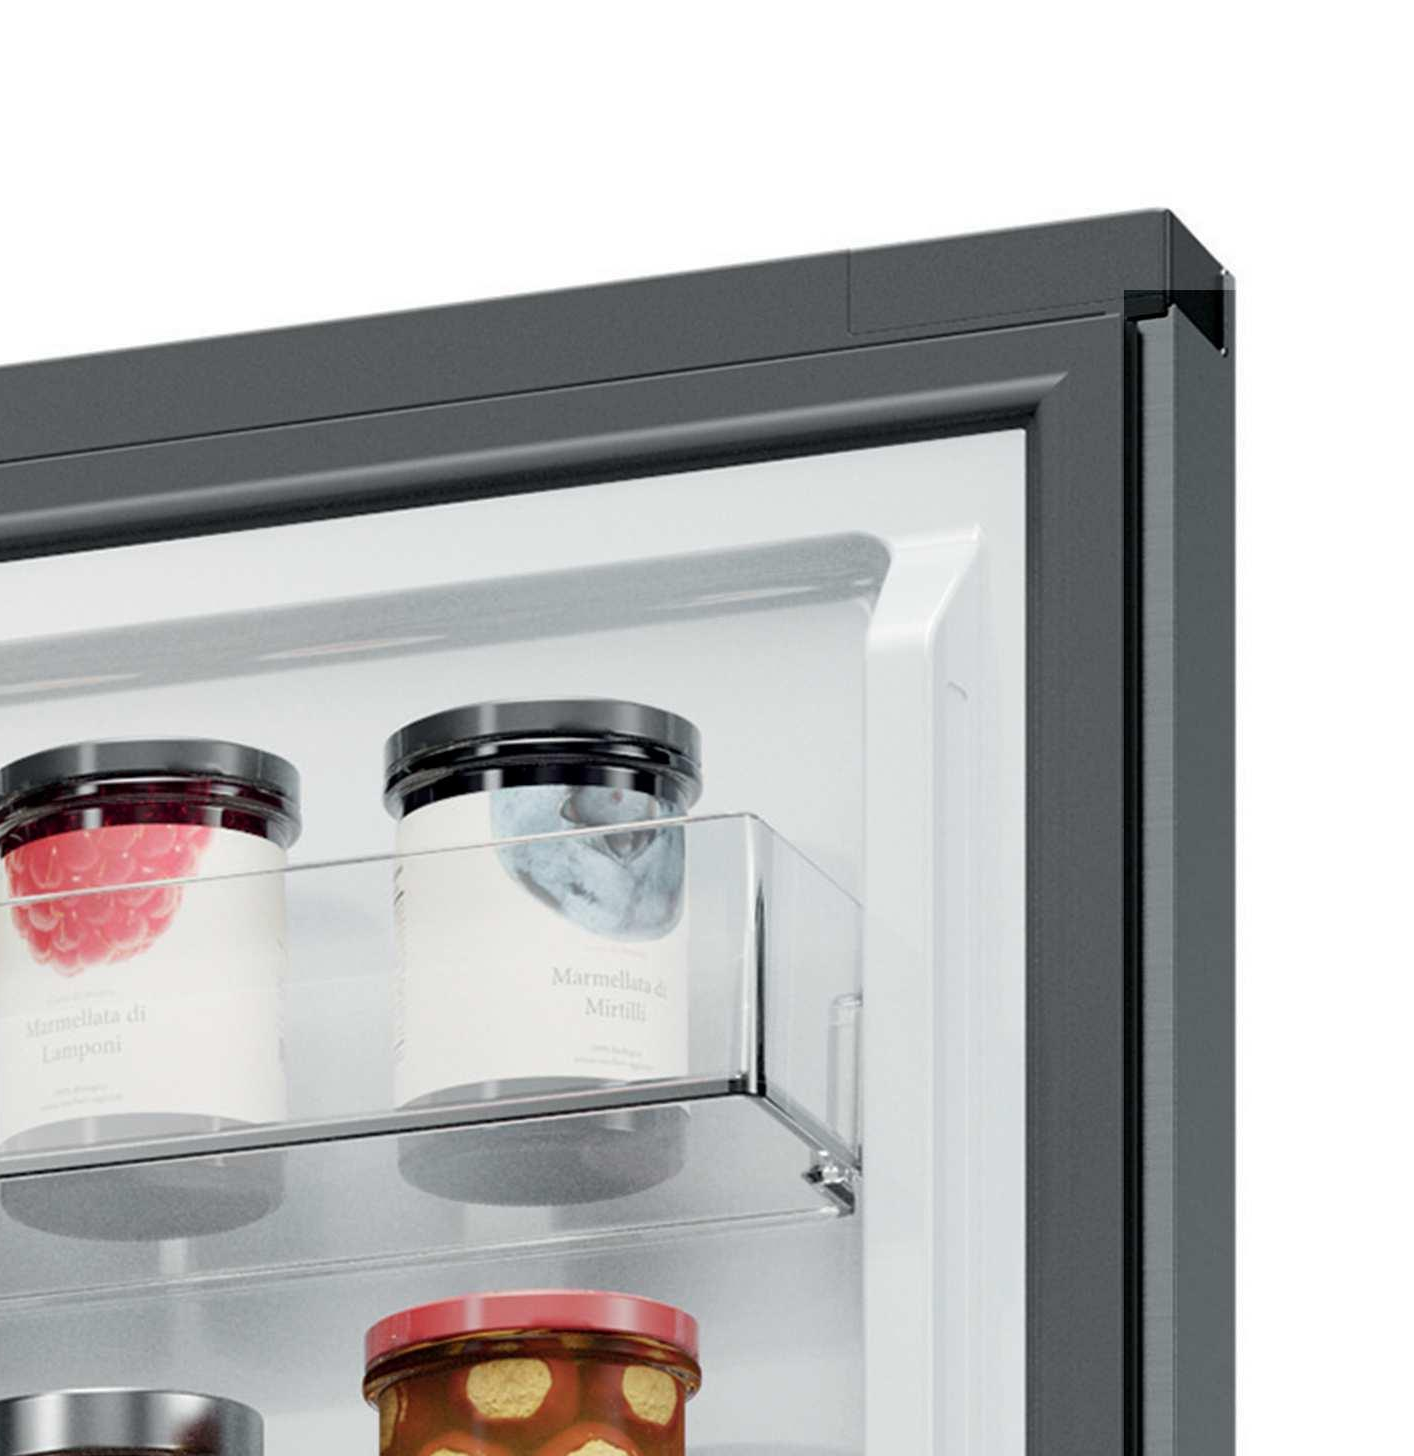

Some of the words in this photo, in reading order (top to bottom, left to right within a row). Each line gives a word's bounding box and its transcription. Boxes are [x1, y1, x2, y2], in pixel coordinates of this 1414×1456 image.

[550, 965, 652, 994] Marmellata
[25, 1007, 121, 1038] Marmellata
[126, 1002, 147, 1024] di
[584, 995, 647, 1022] Mirtilli
[42, 1033, 123, 1063] Lamponi
